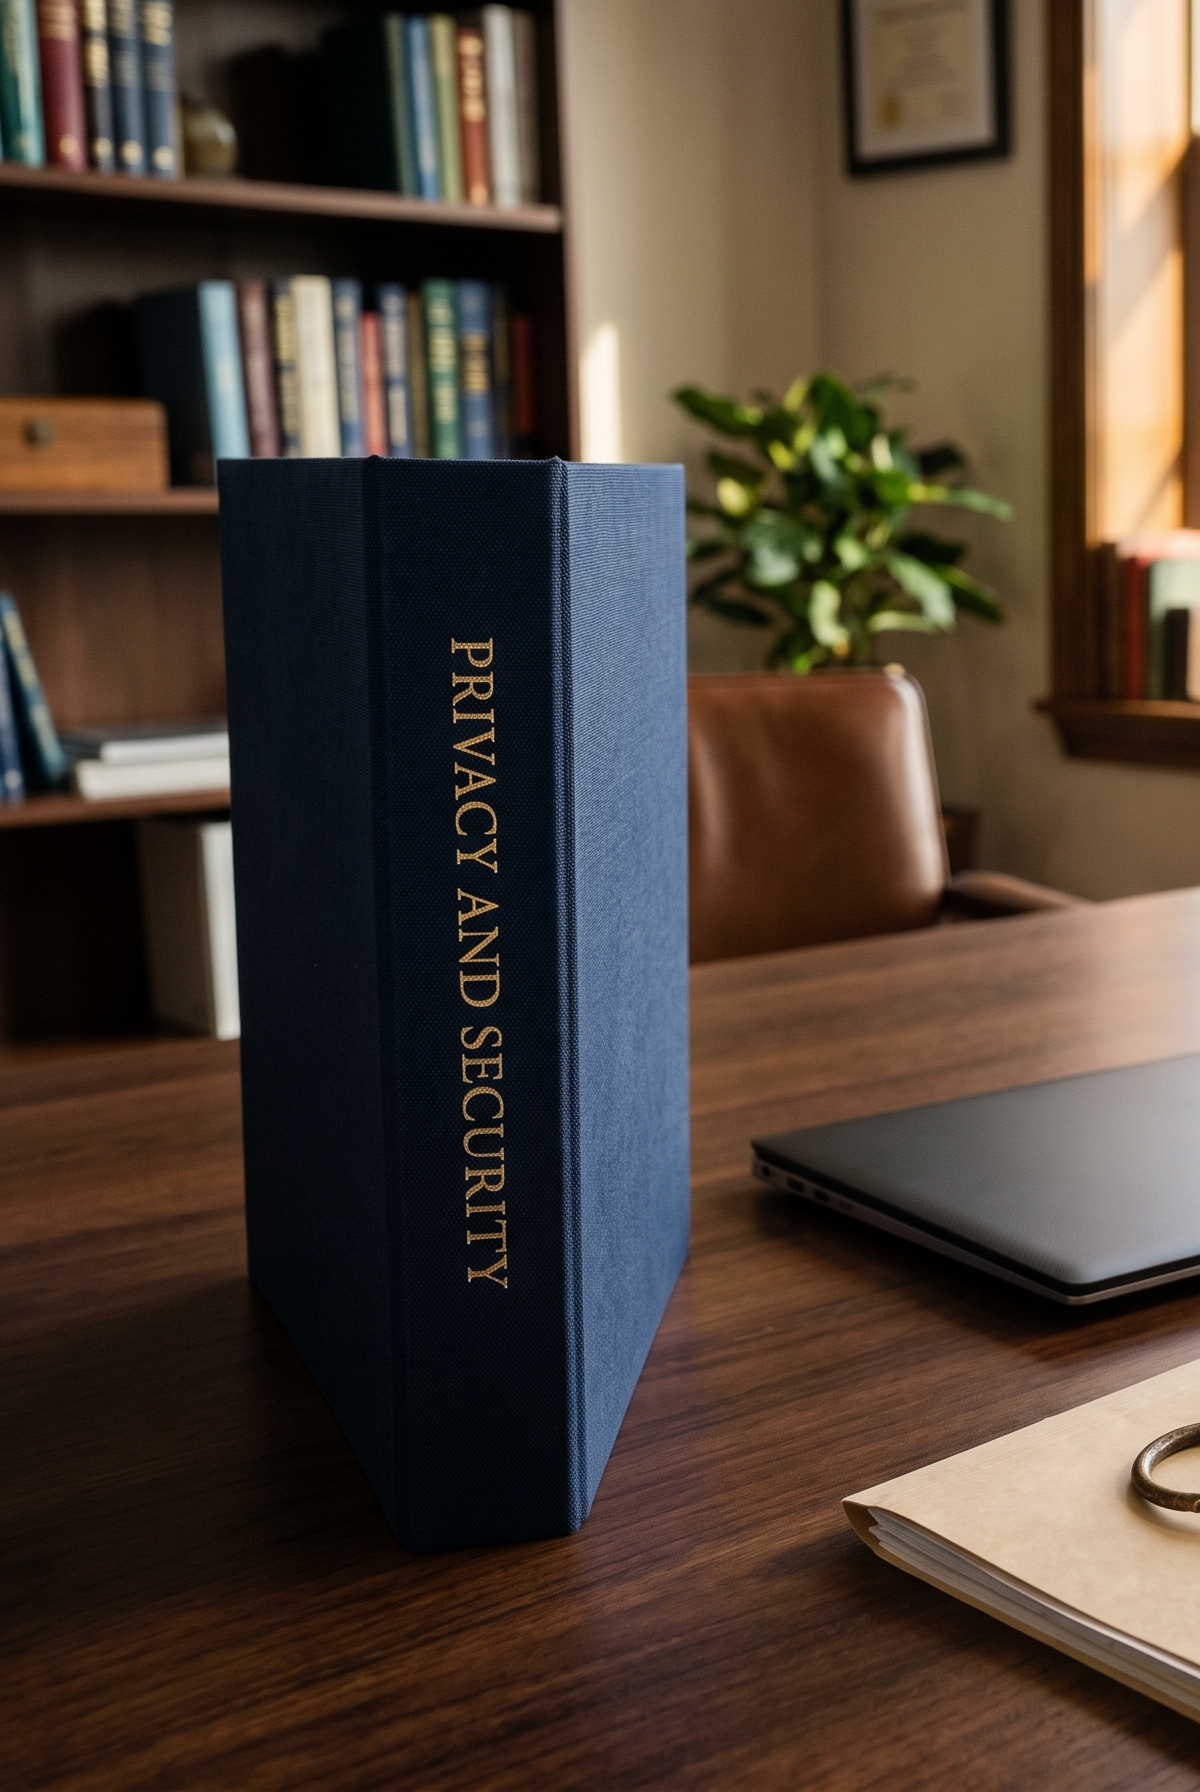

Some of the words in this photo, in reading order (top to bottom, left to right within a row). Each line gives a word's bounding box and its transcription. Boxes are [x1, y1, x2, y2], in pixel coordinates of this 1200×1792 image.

[452, 638, 499, 874] PRIVACY
[457, 887, 500, 1008] AND
[461, 1025, 508, 1289] SECURITY
